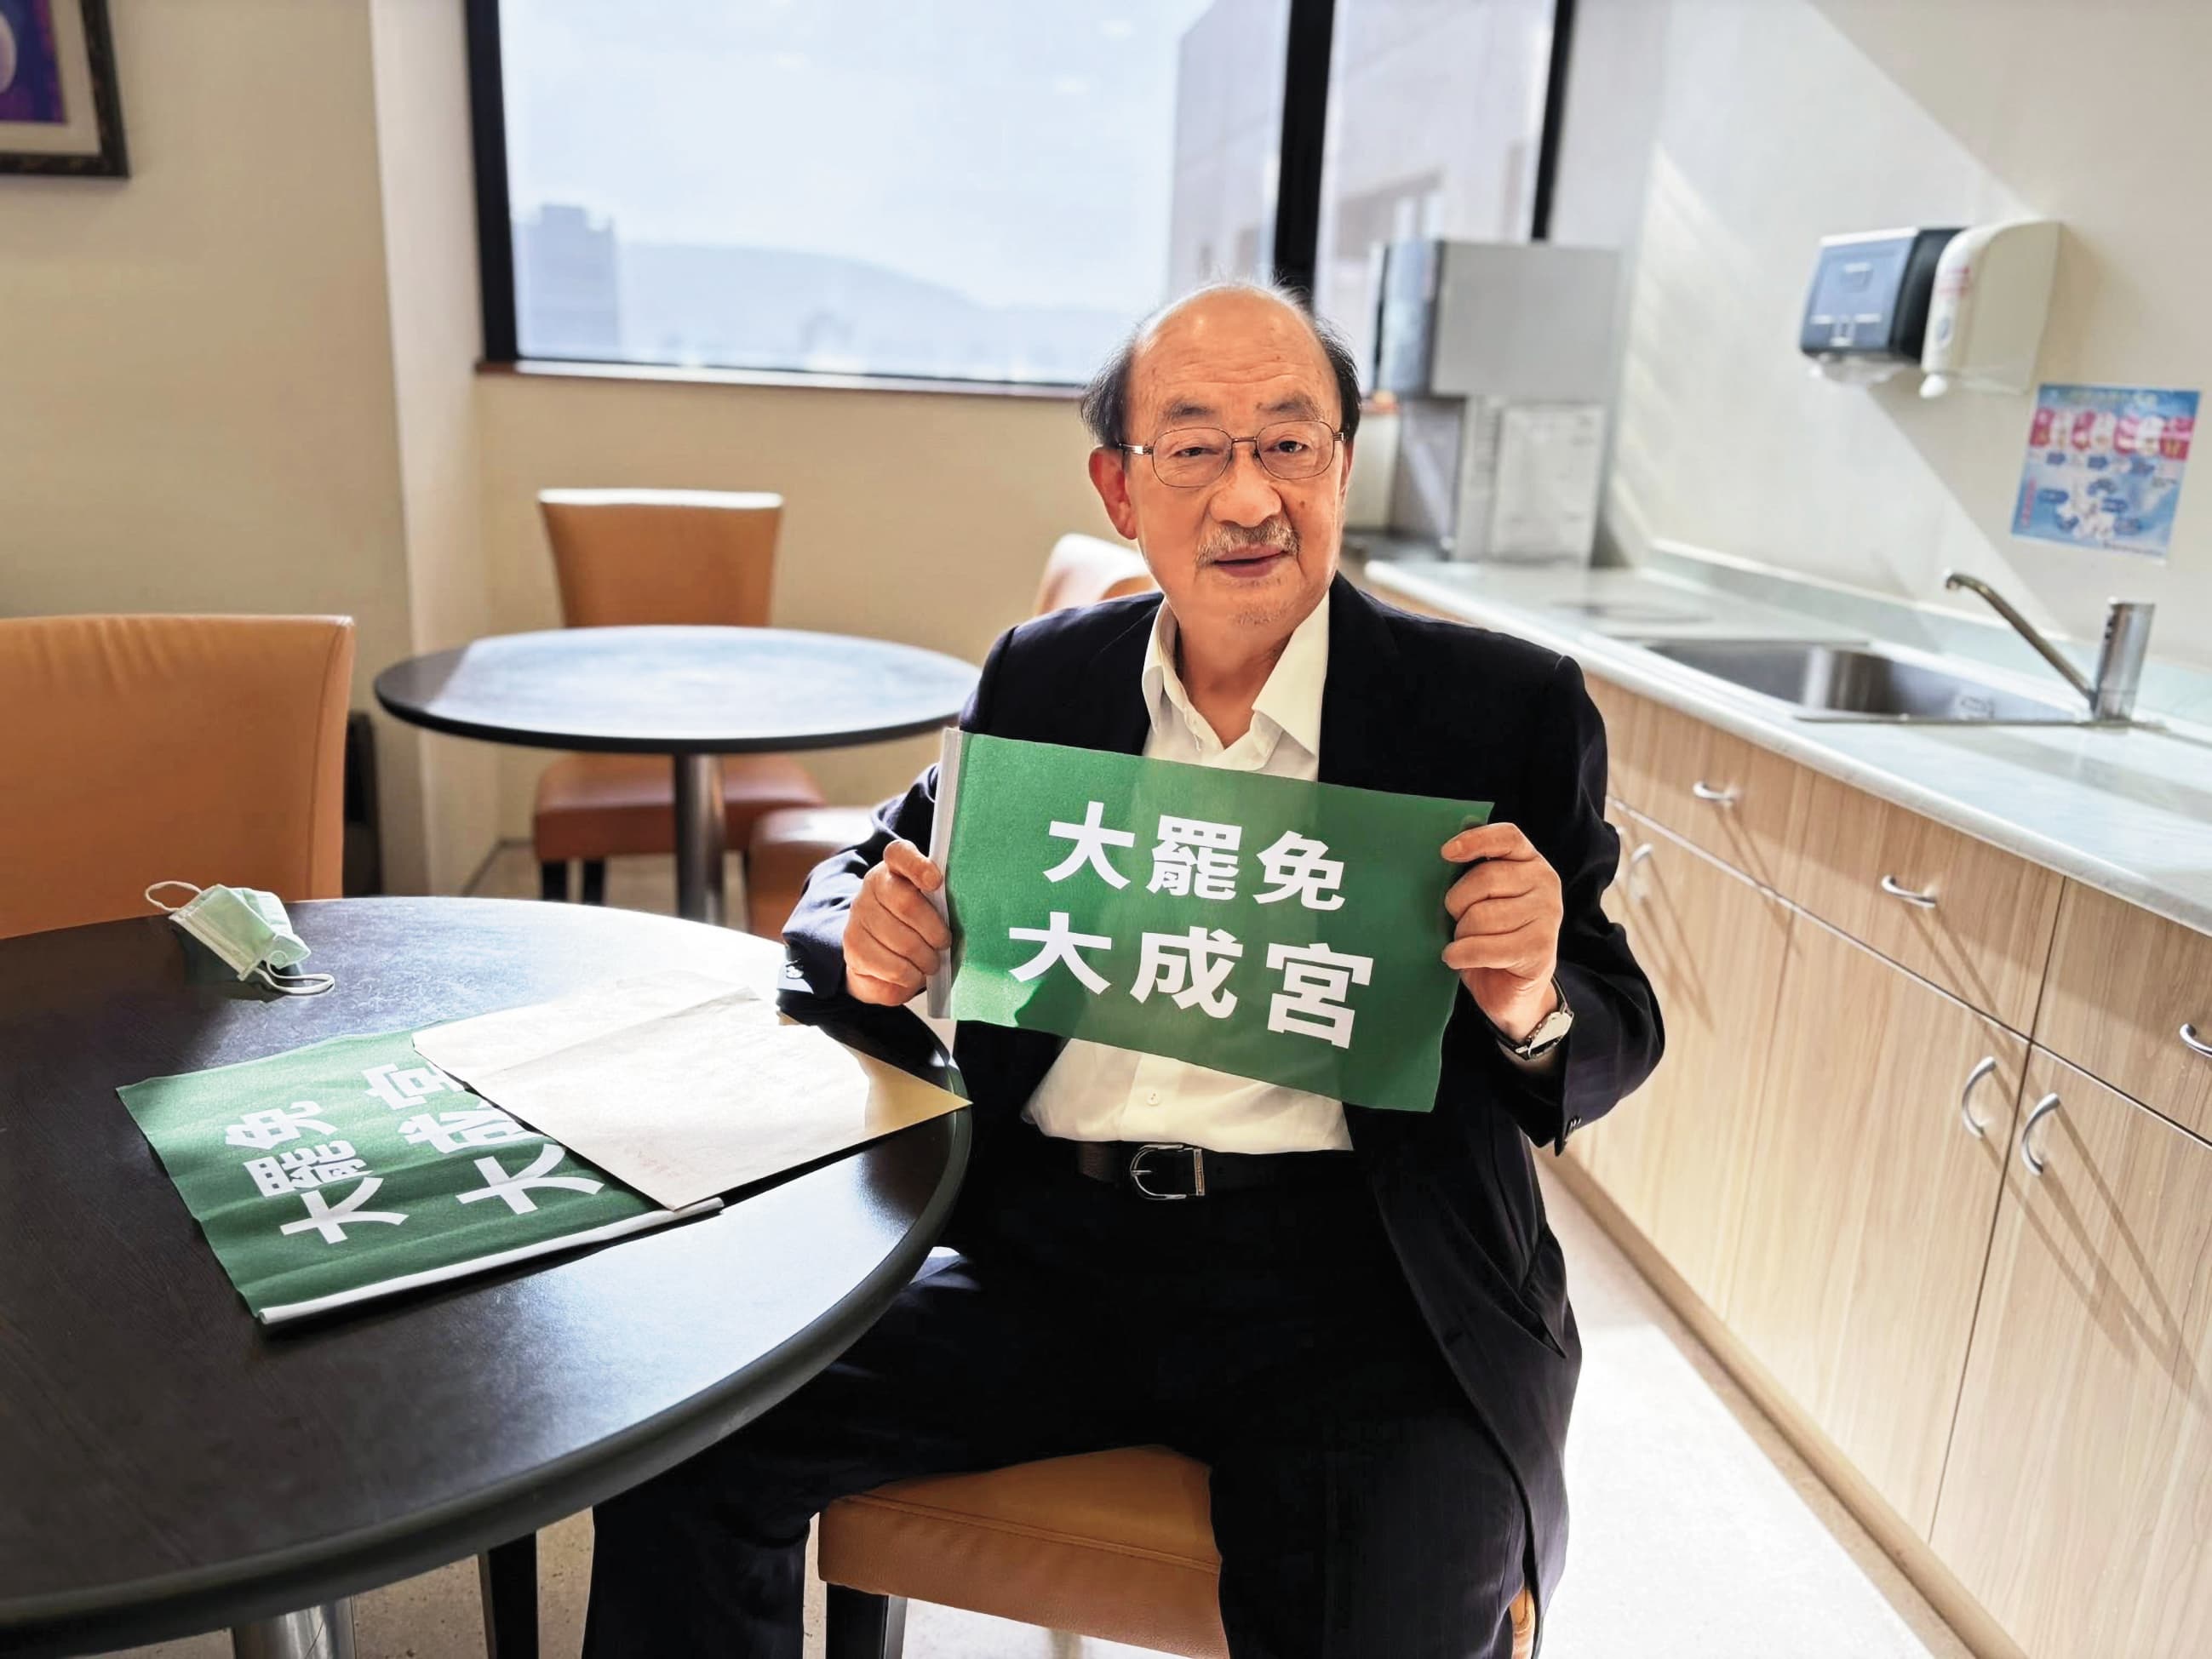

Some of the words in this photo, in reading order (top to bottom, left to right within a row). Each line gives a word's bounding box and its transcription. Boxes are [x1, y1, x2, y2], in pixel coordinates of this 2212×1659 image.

[1042, 801, 1345, 910] 大罷免
[1008, 912, 1373, 1050] 大成宮
[225, 1101, 409, 1244] 大罷免
